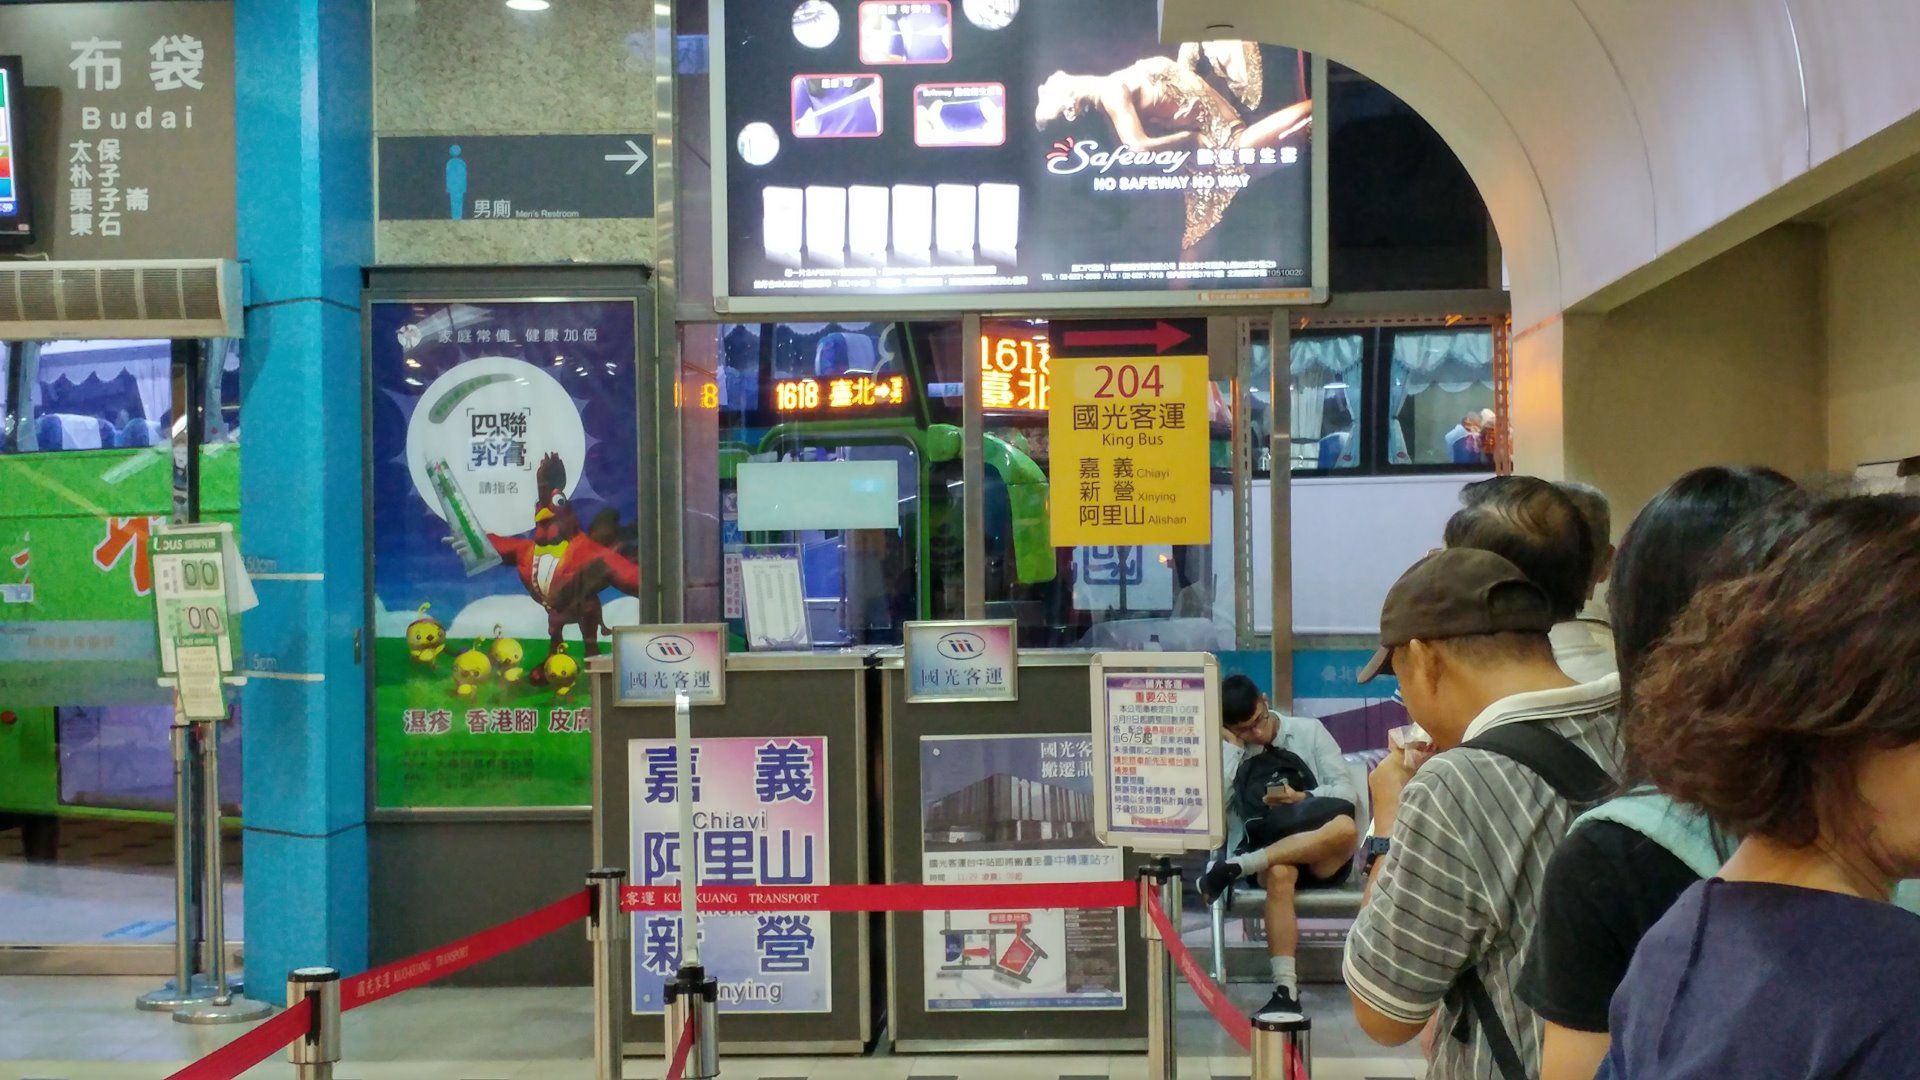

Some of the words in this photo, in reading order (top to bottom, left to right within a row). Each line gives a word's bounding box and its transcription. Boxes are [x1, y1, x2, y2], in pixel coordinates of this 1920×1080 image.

[69, 34, 204, 91] 布袋
[82, 106, 192, 129] Budai
[1047, 140, 1191, 174] Safeway
[1094, 177, 1115, 191] NO
[1119, 175, 1190, 190] SAFEWAY
[1192, 174, 1214, 189] NO
[1217, 174, 1250, 188] WAY
[70, 212, 120, 236] 東石
[541, 209, 579, 218] Restroom
[525, 328, 598, 343] 健康加倍
[1094, 364, 1164, 398] 204
[776, 381, 820, 410] 1618
[1073, 403, 1185, 430] 國光客運
[1102, 433, 1134, 448] King
[1138, 434, 1164, 446] Bus
[1079, 457, 1134, 479] 嘉義
[1136, 468, 1170, 479] Chiayi
[1080, 480, 1135, 502] 新營
[1138, 491, 1176, 503] Xinying
[1079, 504, 1145, 527] 阿里山
[1148, 514, 1187, 525] Alishan
[630, 670, 711, 689] 國光客運
[921, 667, 1003, 687] 國光客運
[404, 708, 452, 734] 濕疹
[465, 708, 539, 734] 香港腳
[643, 742, 815, 804] 嘉義
[643, 830, 813, 885] 阿里山
[620, 891, 656, 905] 客運
[748, 892, 820, 904] TRANSPORT
